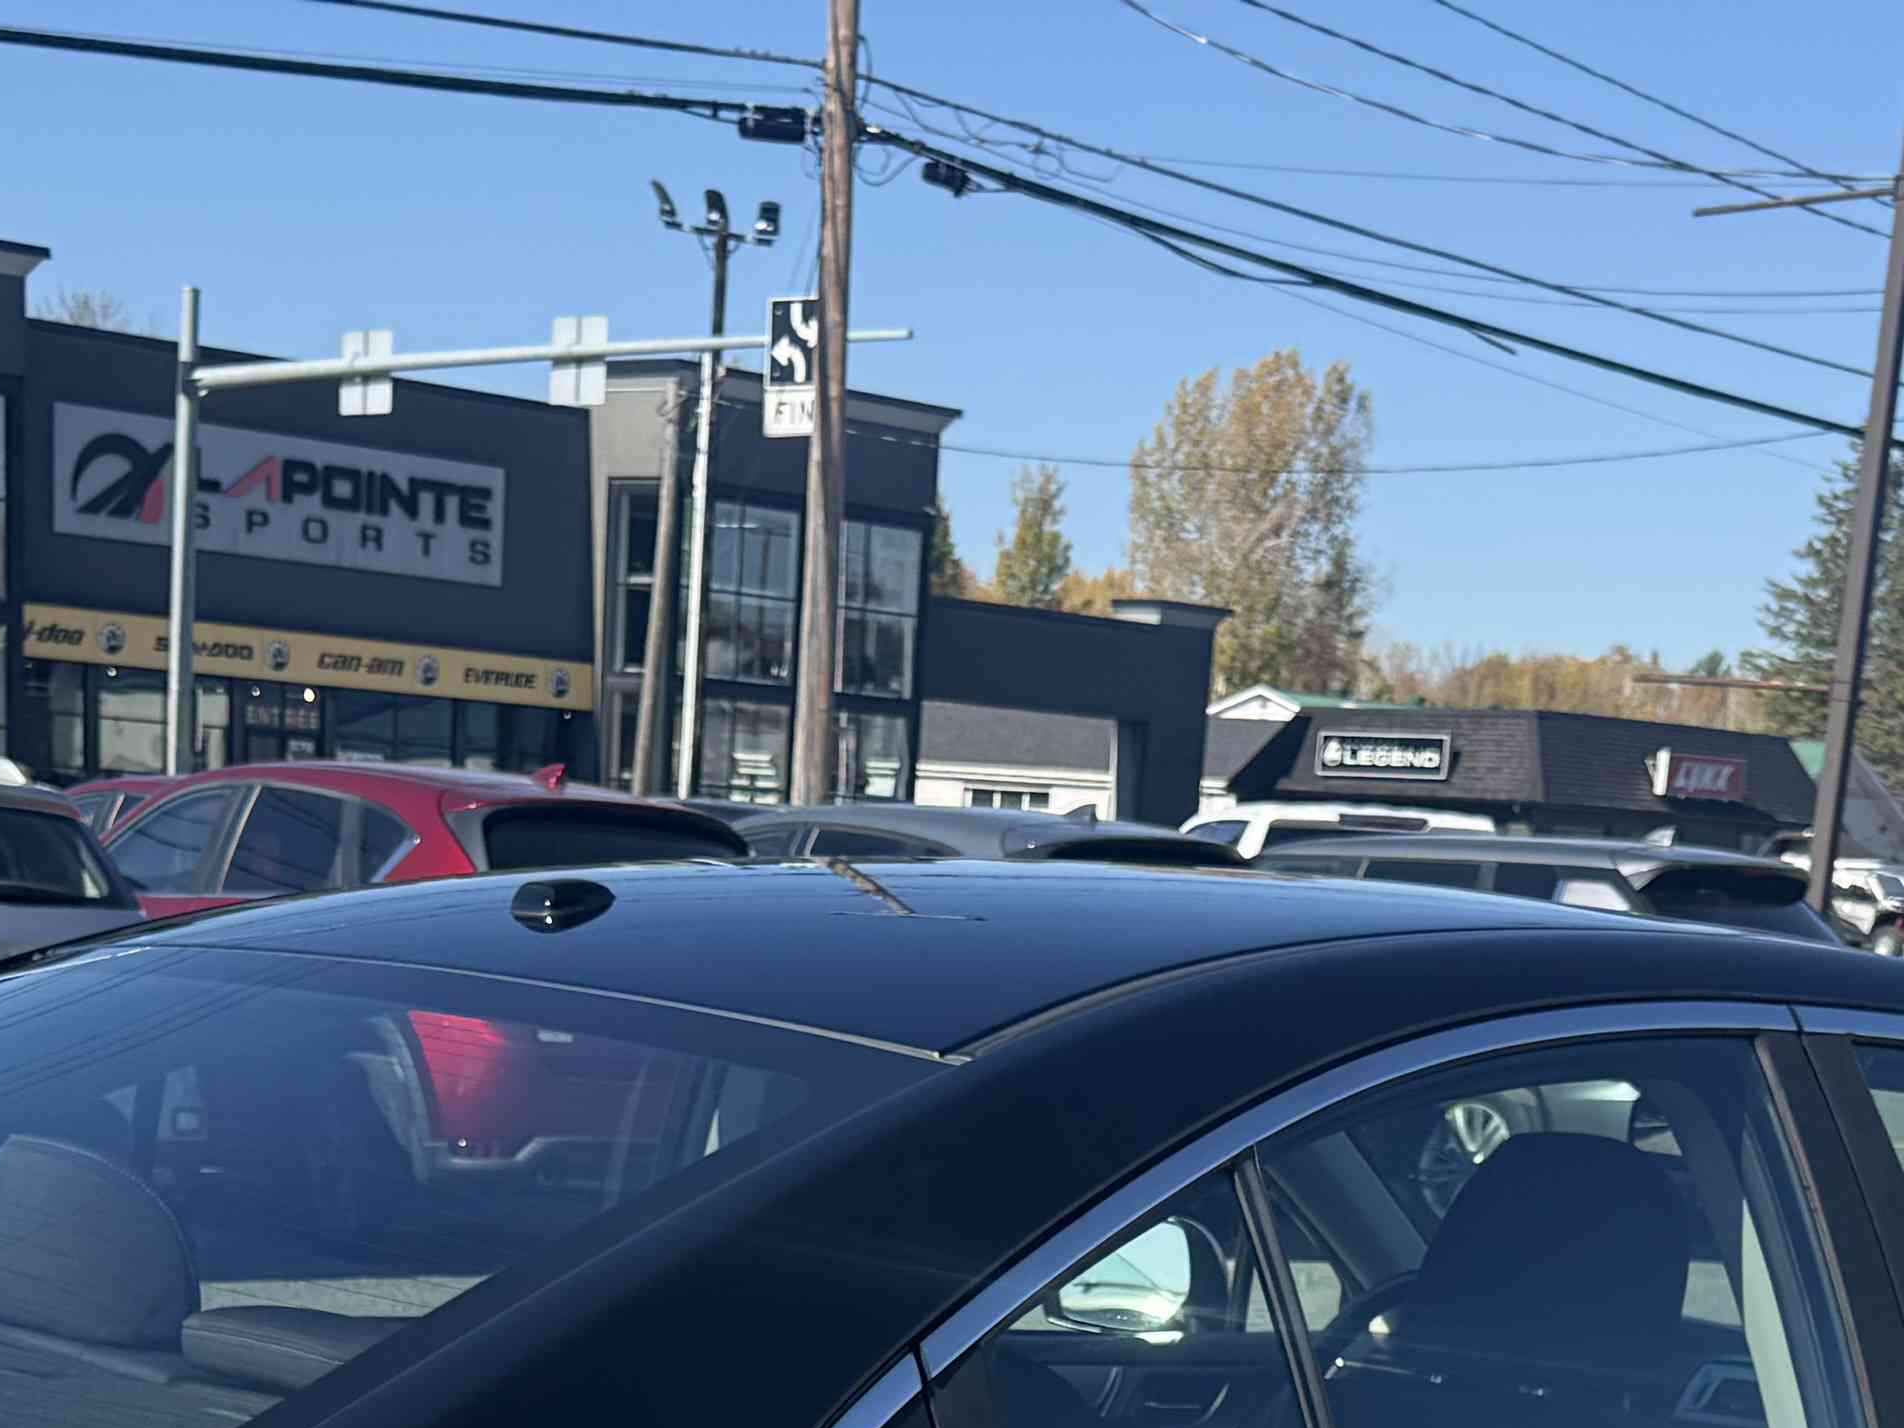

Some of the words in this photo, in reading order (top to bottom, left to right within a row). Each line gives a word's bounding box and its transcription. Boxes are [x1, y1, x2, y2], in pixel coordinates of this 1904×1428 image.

[195, 446, 492, 530] LAPOINTE
[195, 503, 492, 566] SPORTS
[317, 652, 406, 676] can-am
[1343, 746, 1441, 768] LEGEND
